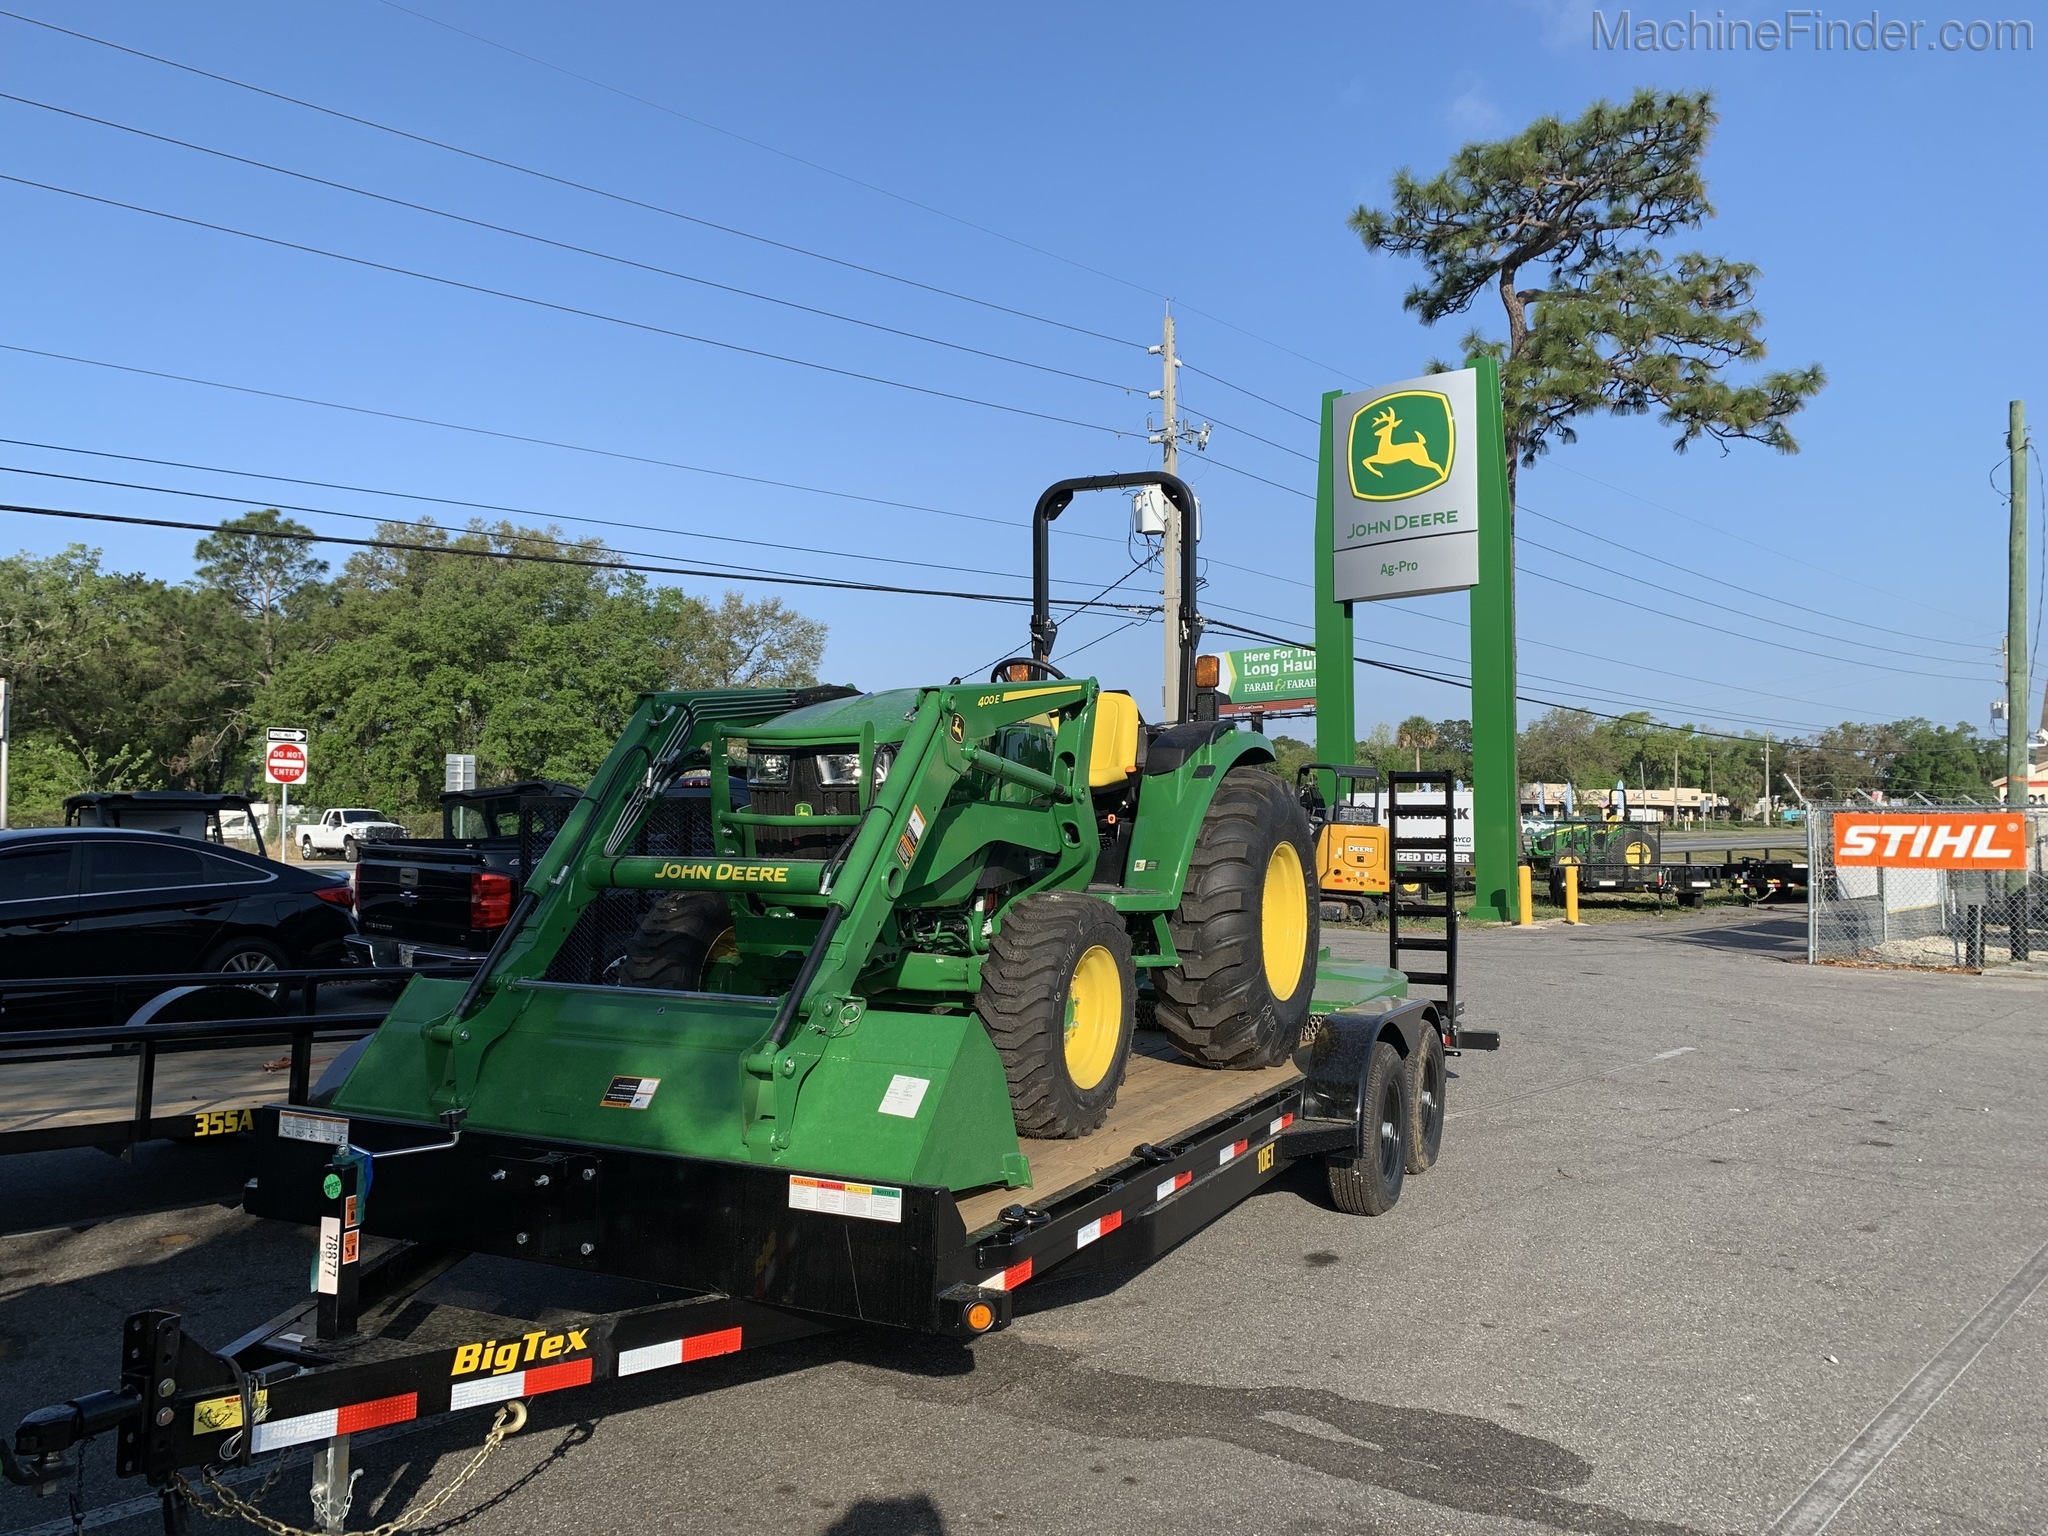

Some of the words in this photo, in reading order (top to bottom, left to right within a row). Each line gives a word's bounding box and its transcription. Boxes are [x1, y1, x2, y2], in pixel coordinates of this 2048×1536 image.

[1346, 519, 1391, 539] JOHN
[1394, 510, 1458, 531] DEERE
[1380, 560, 1418, 576] Ag-Pro
[1243, 651, 1270, 663] Here
[1273, 649, 1293, 660] For
[1244, 662, 1279, 676] Long
[1283, 657, 1316, 673] Haul
[1244, 681, 1273, 692] FARAH
[1287, 678, 1317, 689] FARAH
[286, 751, 302, 759] NOT
[273, 768, 300, 776] ENTER
[1348, 845, 1375, 853] DEERE
[1839, 825, 2012, 858] STIHL
[1424, 853, 1470, 862] DEAER
[655, 862, 712, 880] JOHN
[716, 863, 789, 883] DEERE
[194, 1108, 254, 1137] 35SA
[1257, 1142, 1275, 1174] 10ET
[324, 1234, 338, 1277] 78877
